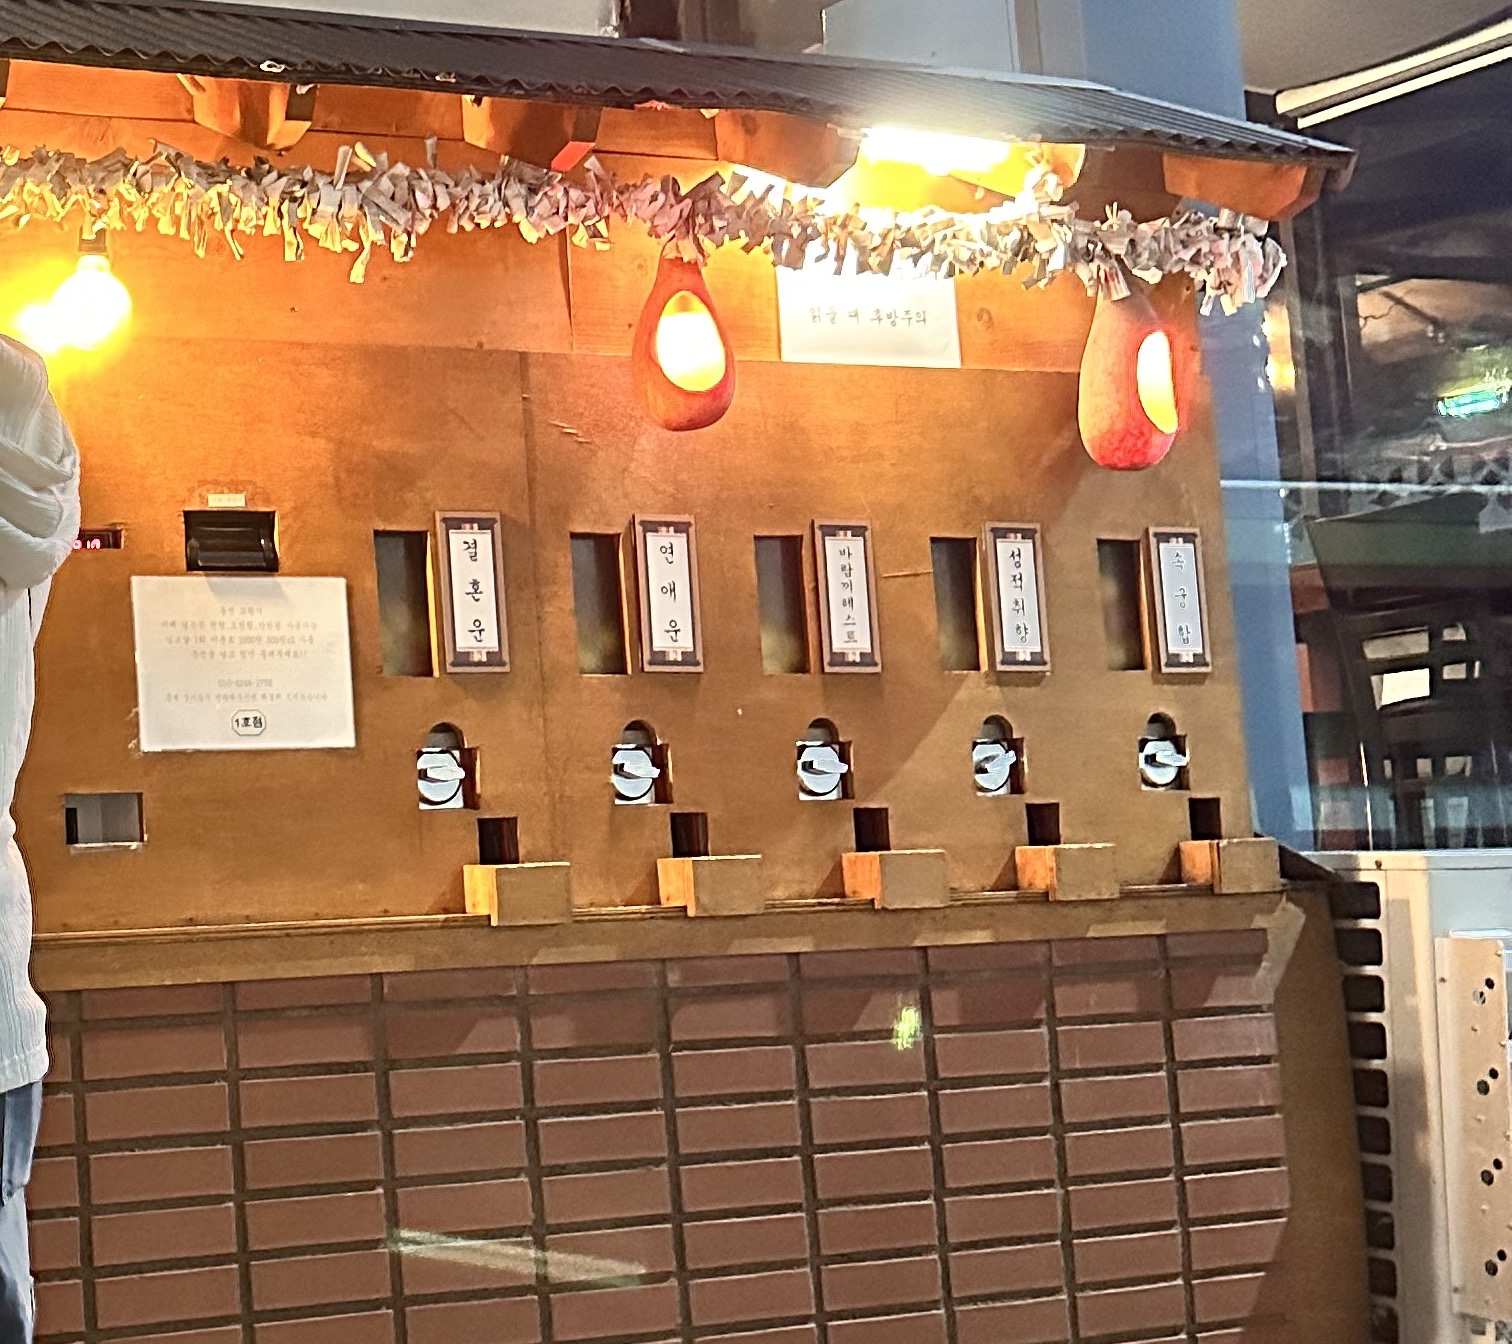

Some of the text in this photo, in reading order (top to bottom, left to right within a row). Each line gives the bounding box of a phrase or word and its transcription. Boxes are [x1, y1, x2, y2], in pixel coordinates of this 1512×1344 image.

[870, 308, 927, 327] 후방주의
[462, 538, 486, 643] 결혼운
[659, 541, 681, 643] 연애운
[1009, 547, 1029, 644] 성적취향
[1171, 551, 1191, 645] 속궁합
[234, 716, 263, 729] 1호점
